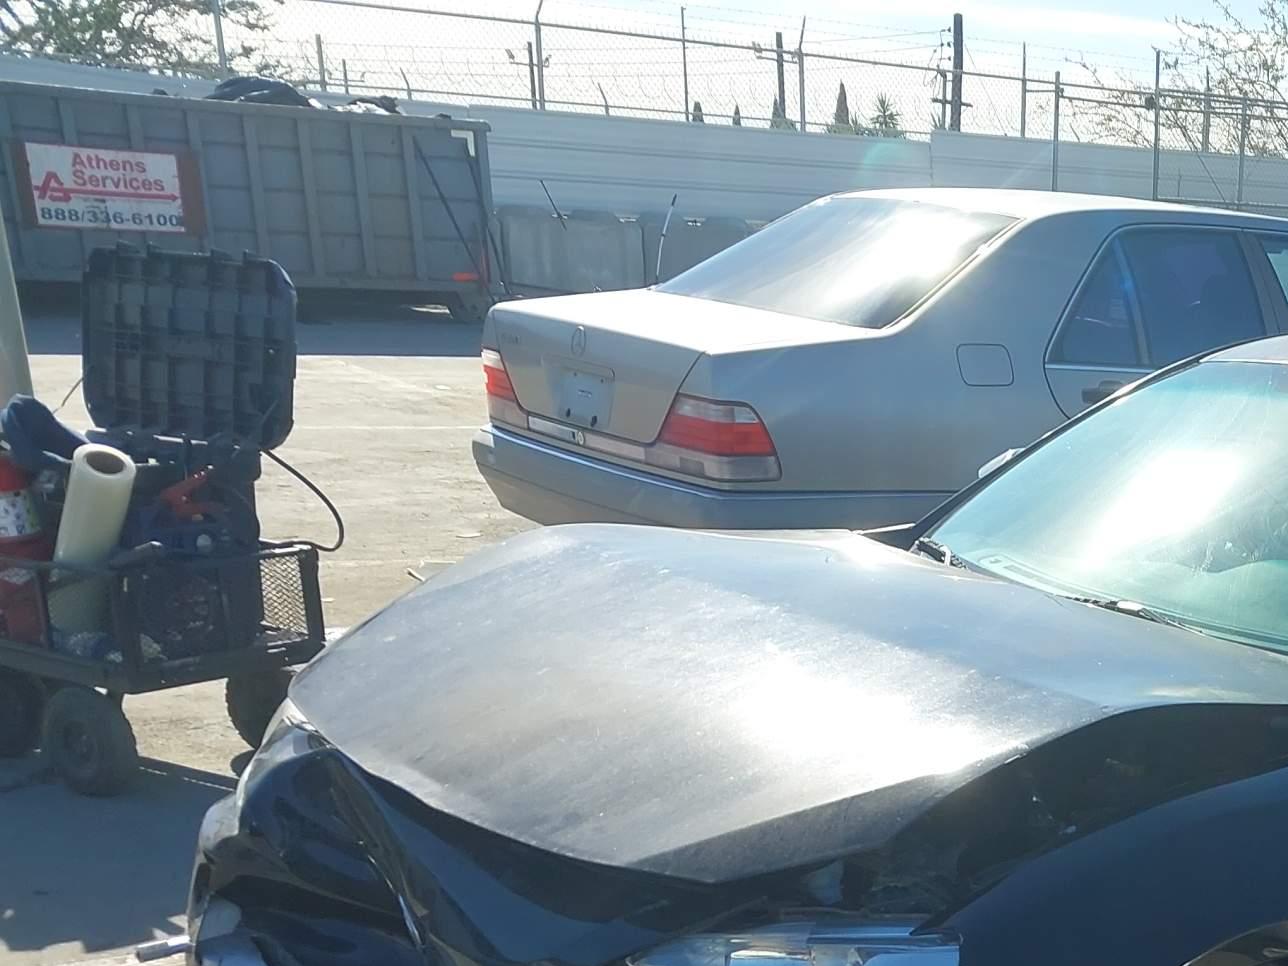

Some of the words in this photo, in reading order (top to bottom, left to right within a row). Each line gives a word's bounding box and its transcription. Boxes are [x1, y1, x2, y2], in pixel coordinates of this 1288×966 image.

[71, 152, 147, 174] Athens
[72, 169, 165, 192] Services
[40, 206, 179, 227] 888/336-6100
